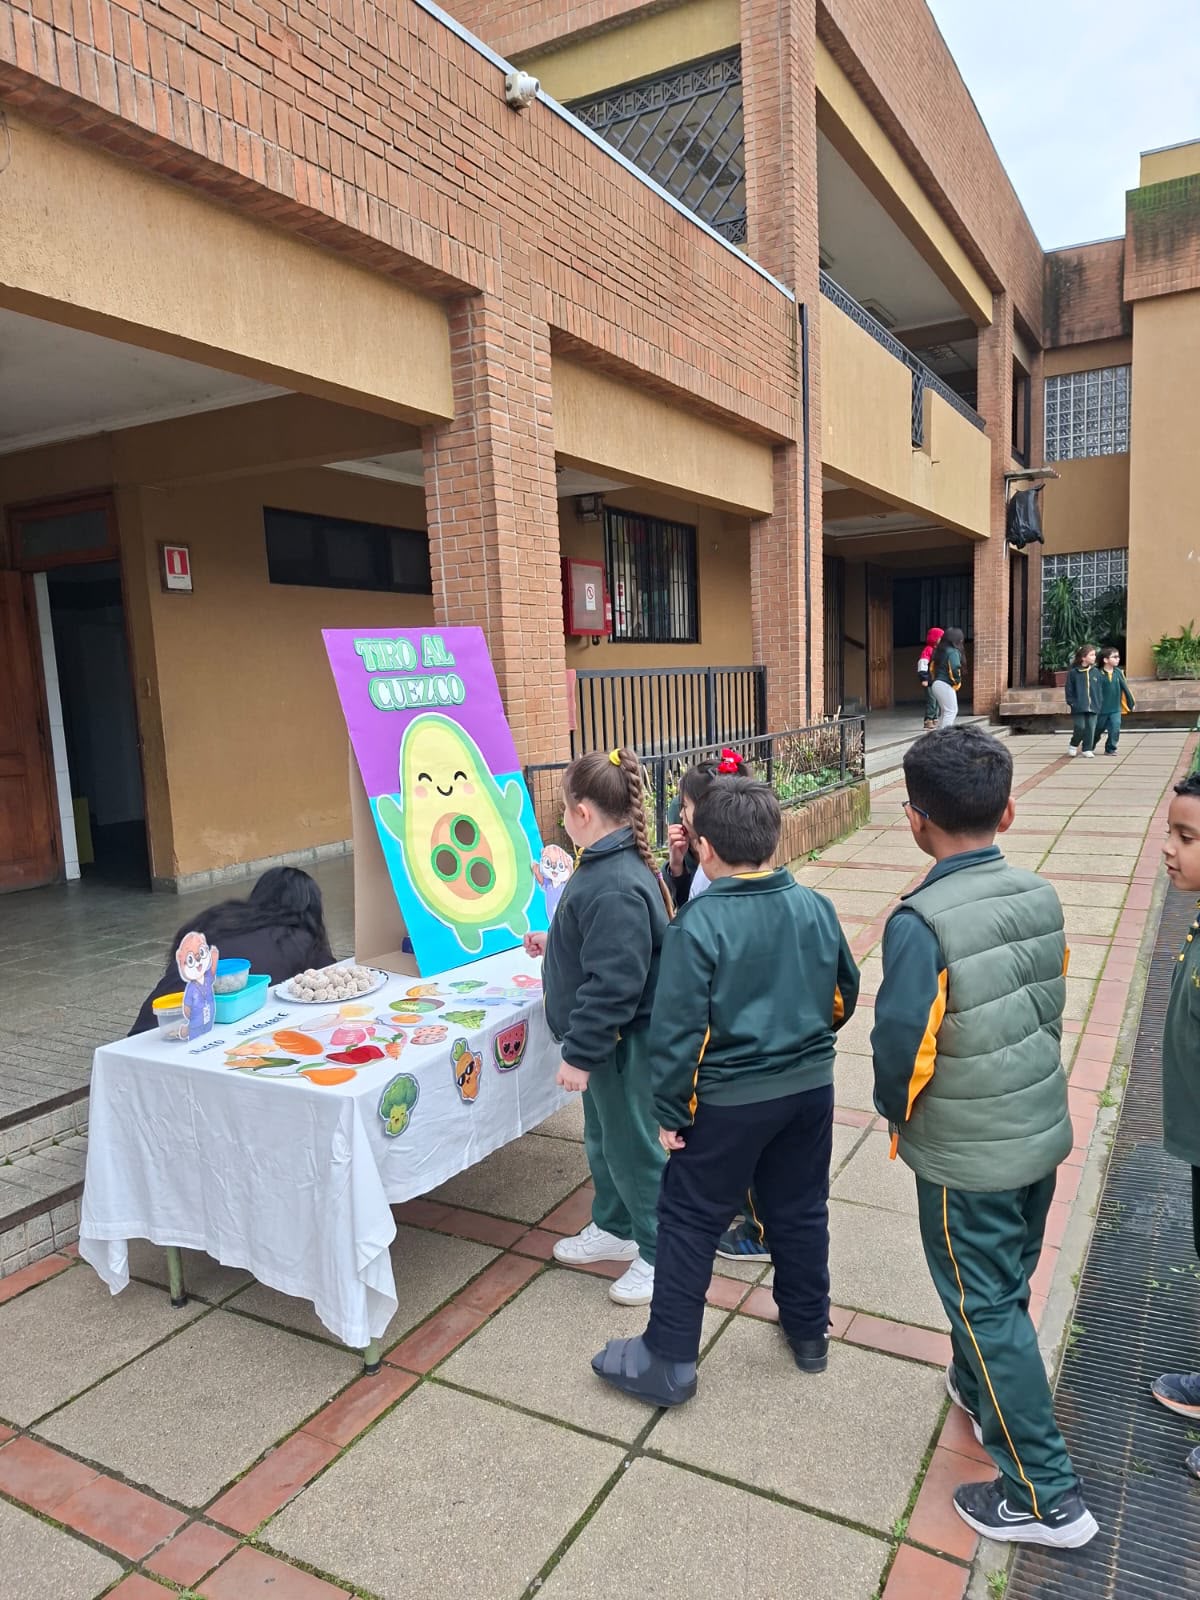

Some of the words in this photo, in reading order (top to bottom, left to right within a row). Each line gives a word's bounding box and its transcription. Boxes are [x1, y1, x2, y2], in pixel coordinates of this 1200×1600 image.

[354, 638, 418, 671] TIRO
[421, 635, 456, 667] AL
[369, 674, 466, 710] CUEZCO
